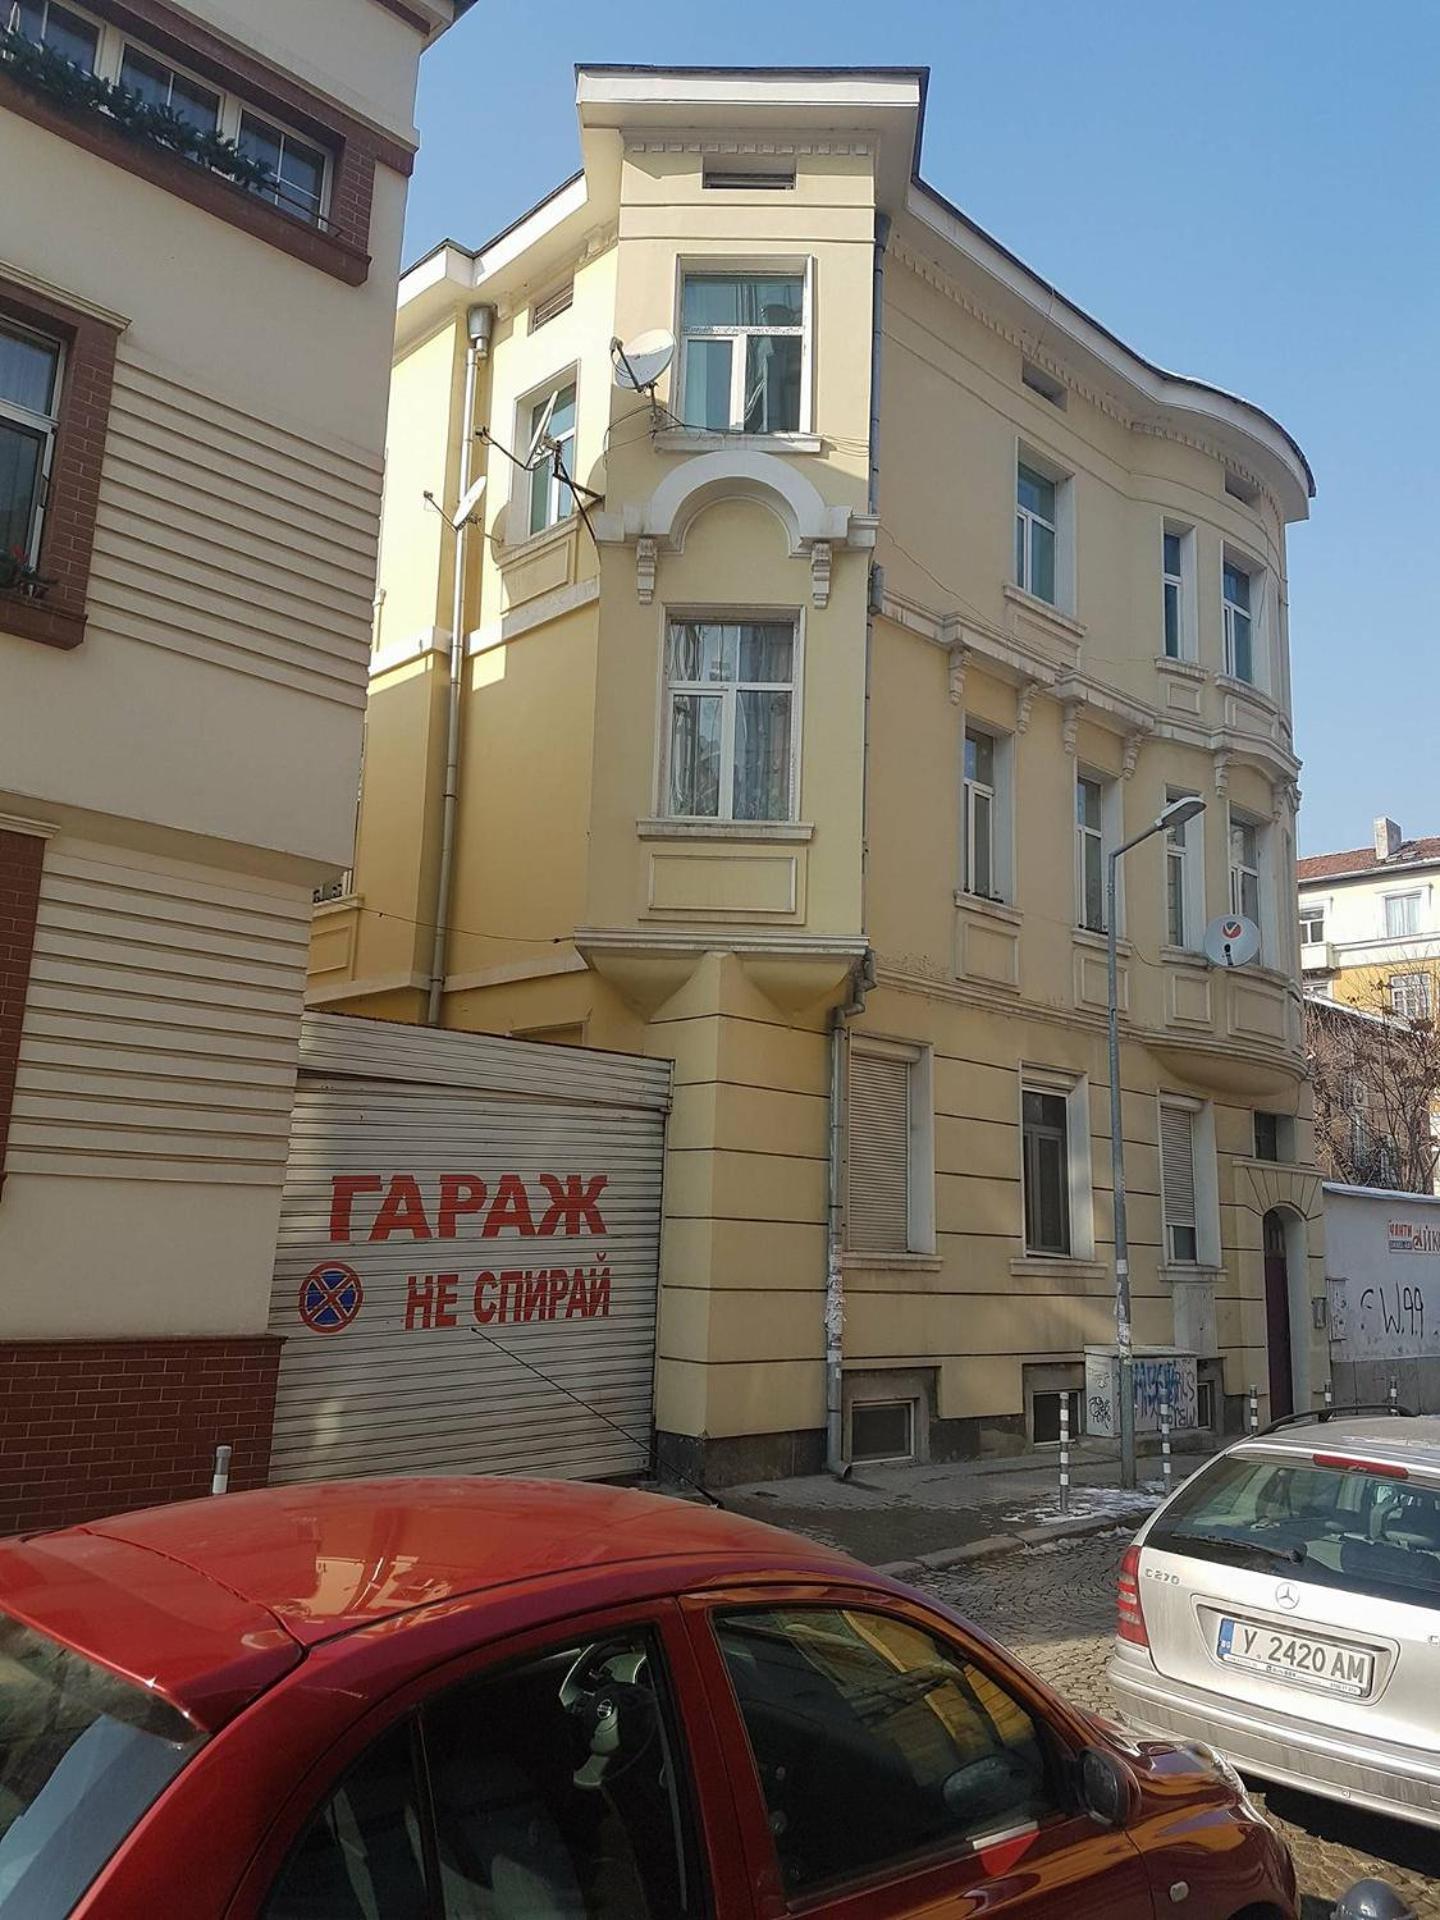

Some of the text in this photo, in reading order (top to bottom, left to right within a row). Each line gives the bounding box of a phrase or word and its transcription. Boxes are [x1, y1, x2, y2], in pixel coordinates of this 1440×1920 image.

[330, 1174, 609, 1241] ГАРАЖ
[405, 1251, 611, 1330] НЕ СПИРАЙ
[1268, 1636, 1326, 1673] 2420
